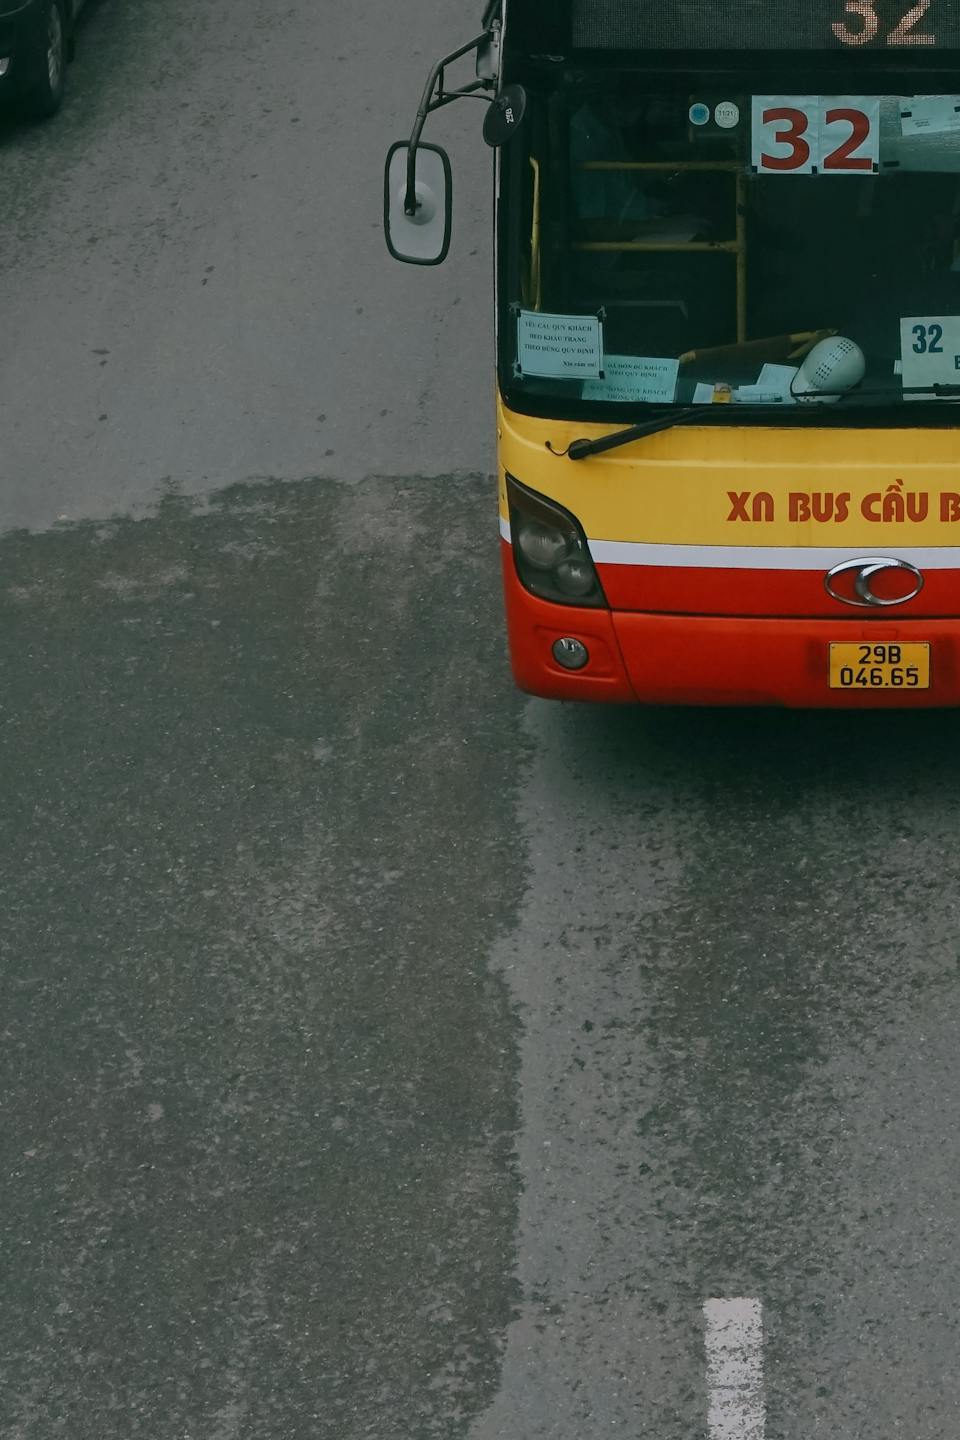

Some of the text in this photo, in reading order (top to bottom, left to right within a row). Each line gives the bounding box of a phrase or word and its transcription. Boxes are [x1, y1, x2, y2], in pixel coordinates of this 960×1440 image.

[761, 108, 873, 171] 32
[912, 324, 943, 354] 32
[788, 491, 851, 522] BUS
[861, 479, 929, 522] CẦU
[858, 646, 901, 664] 29B
[840, 667, 919, 686] 046.65
